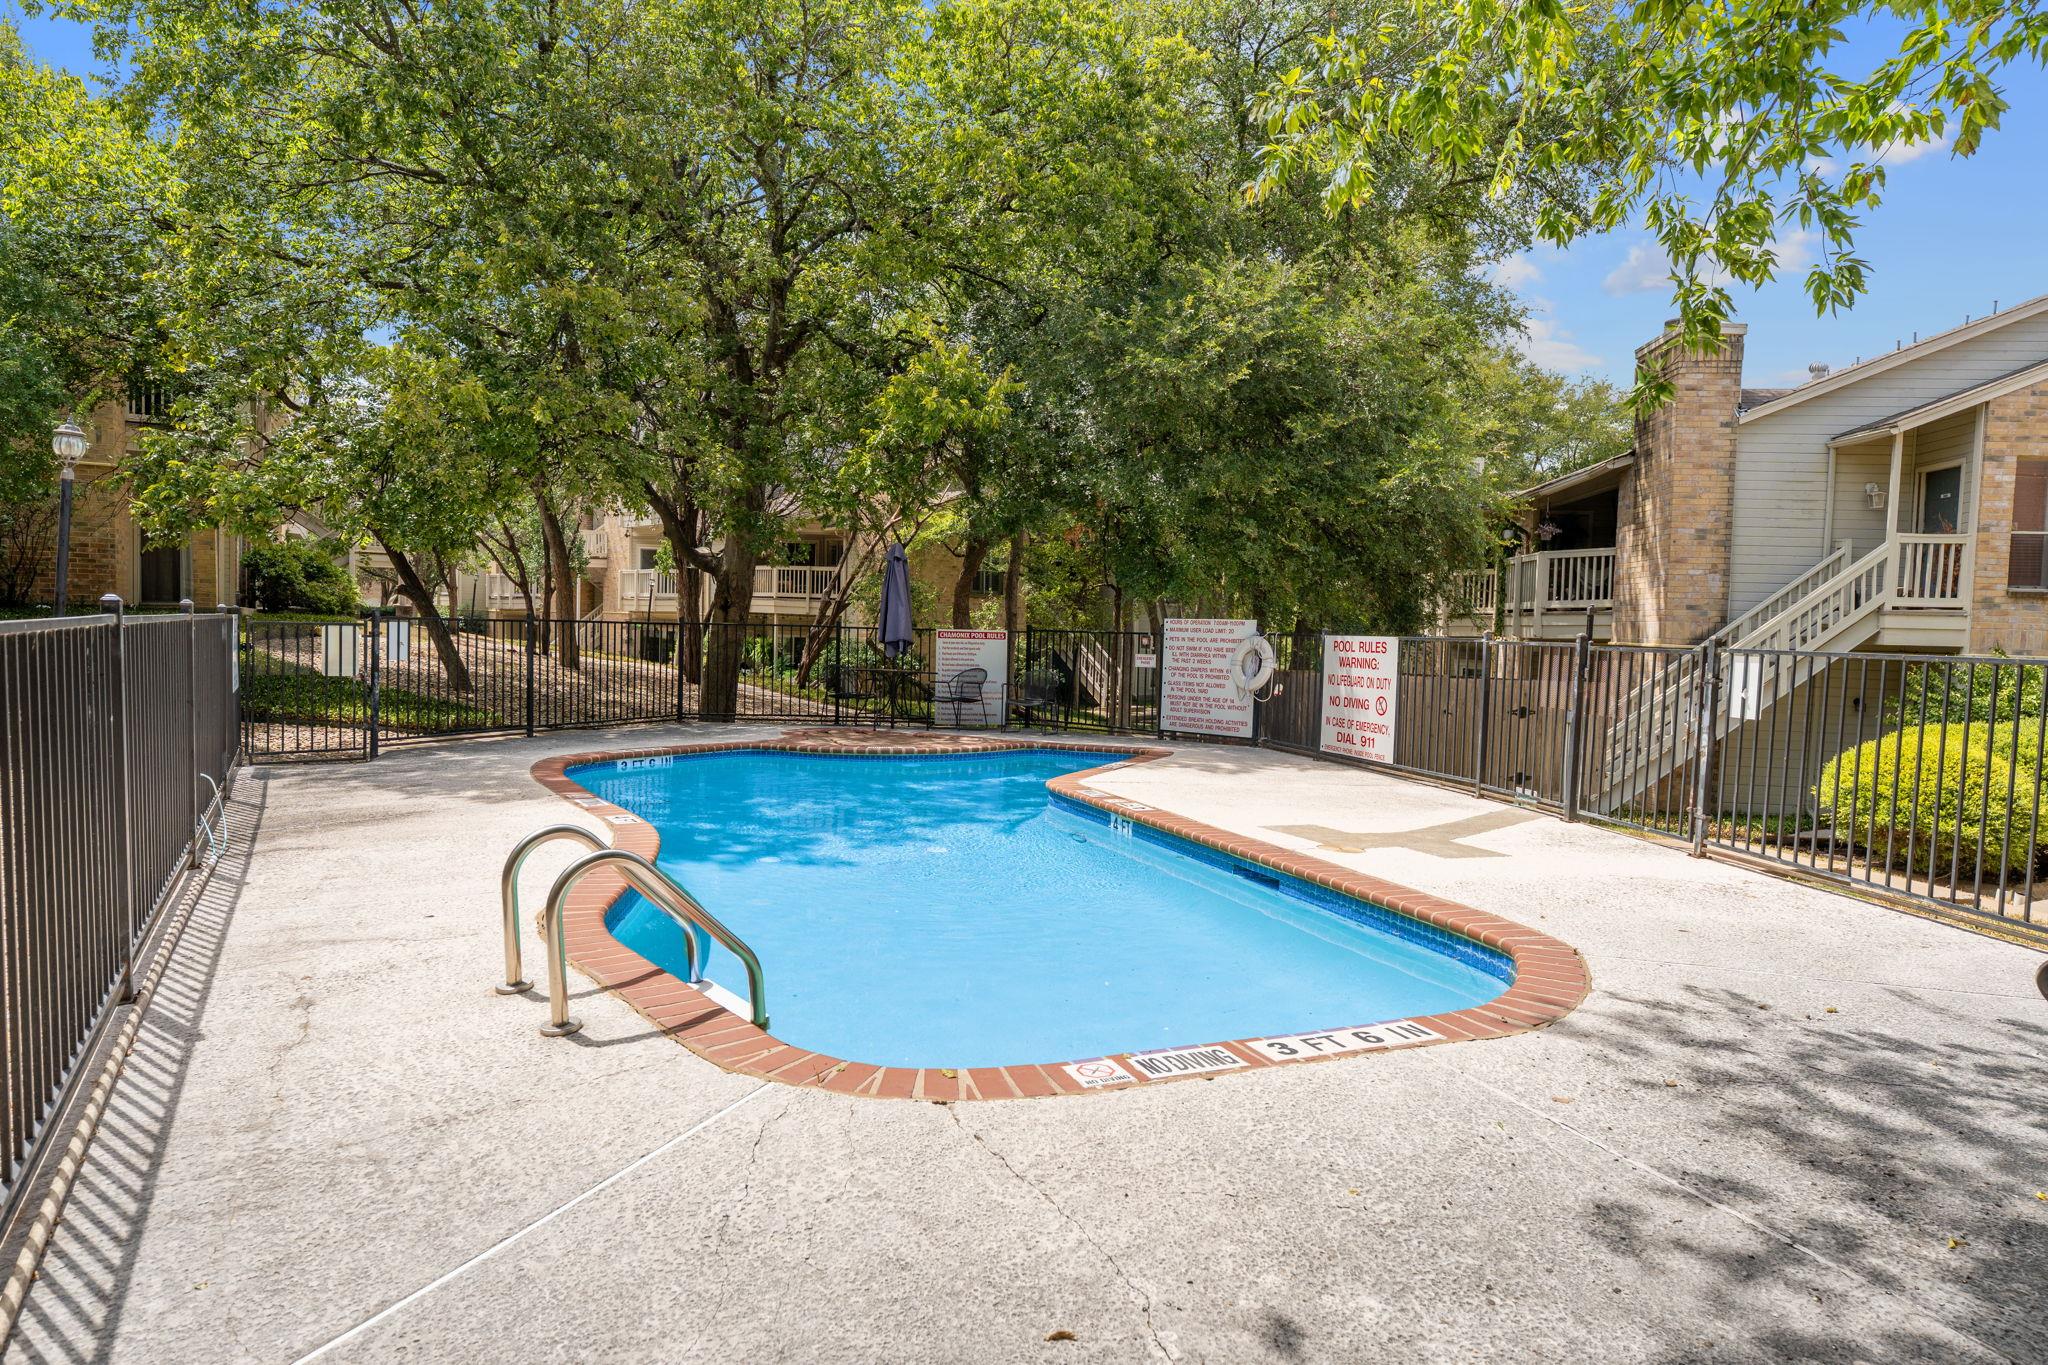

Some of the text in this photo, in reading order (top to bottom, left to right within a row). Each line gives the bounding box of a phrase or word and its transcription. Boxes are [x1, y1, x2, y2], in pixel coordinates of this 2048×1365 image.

[1334, 640, 1387, 654] POOL RULES
[1339, 656, 1380, 670] WARNING:
[1328, 674, 1392, 690] NO LIFEGUARD ON DUTY
[1330, 696, 1369, 710] NO DIVING
[1326, 716, 1330, 726] IN
[1332, 717, 1345, 728] CASE
[1347, 719, 1354, 729] OF
[1337, 732, 1375, 748] DIAL 911
[621, 761, 627, 770] 3
[661, 757, 671, 767] IN
[1113, 816, 1130, 834] 4 FT
[1267, 1024, 1432, 1056] 3 FT 6 IN
[1135, 1049, 1240, 1074] NO DIVING
[1100, 1075, 1130, 1083] DIVING
